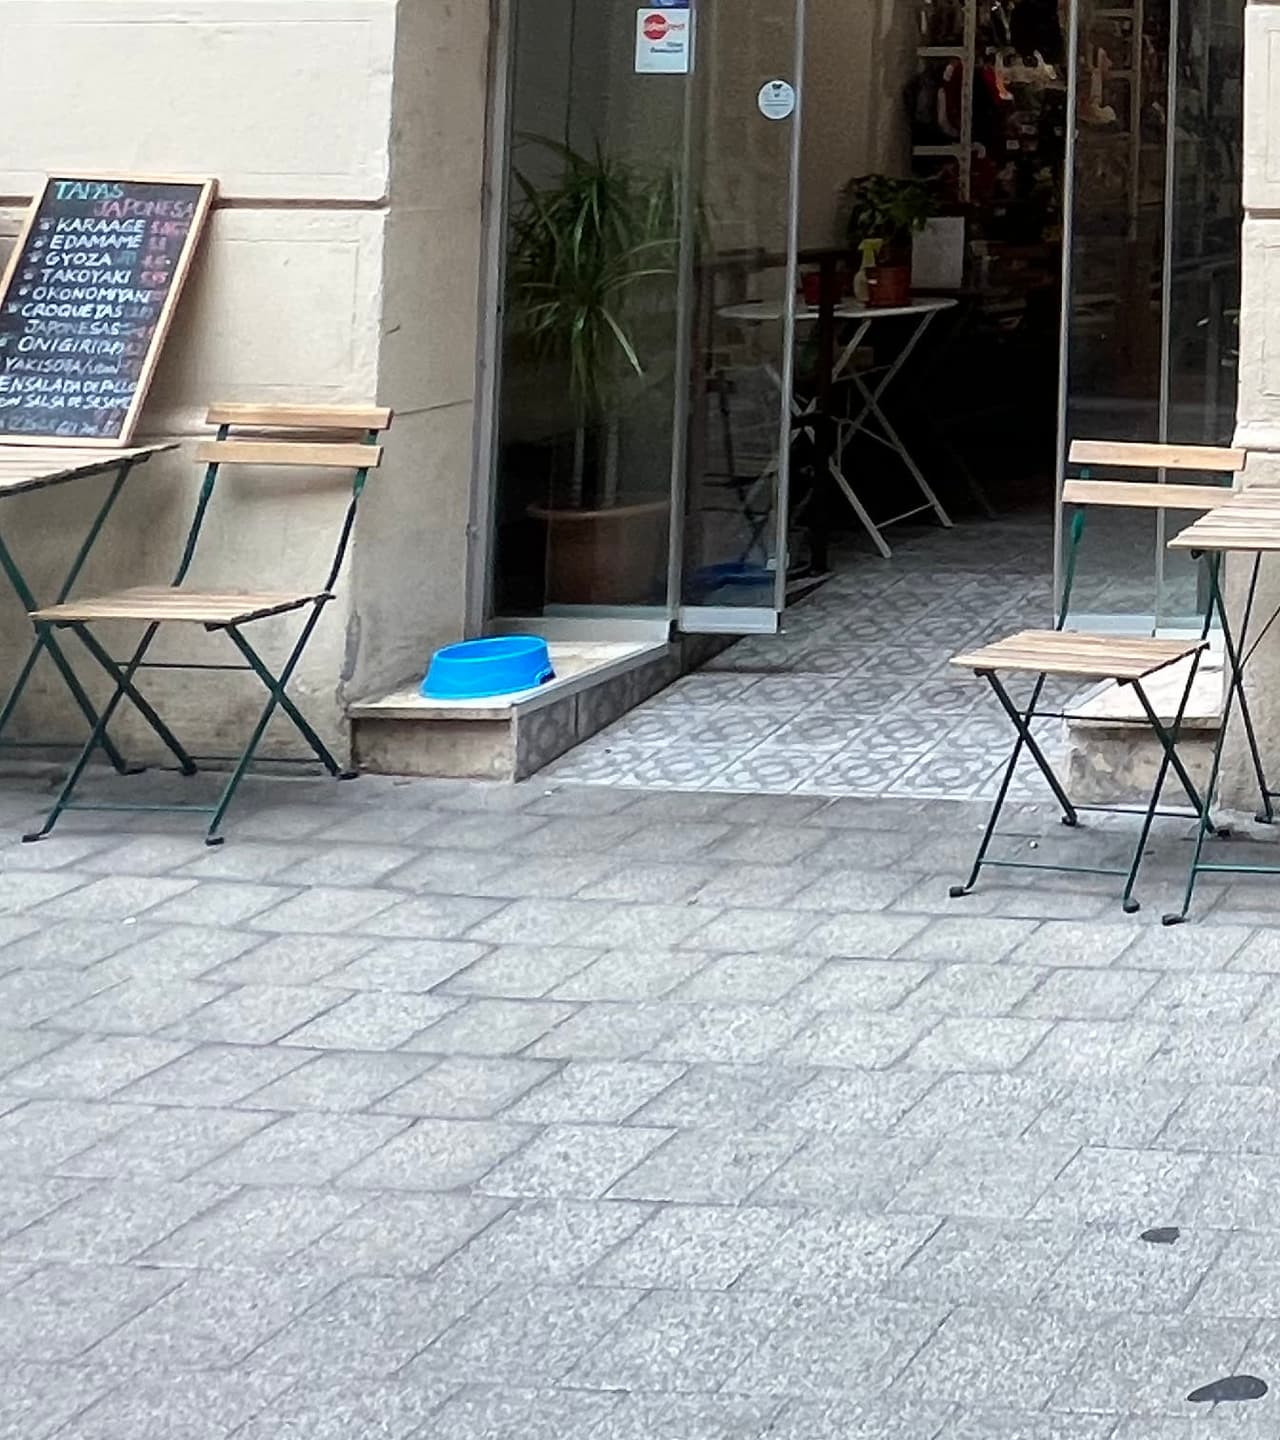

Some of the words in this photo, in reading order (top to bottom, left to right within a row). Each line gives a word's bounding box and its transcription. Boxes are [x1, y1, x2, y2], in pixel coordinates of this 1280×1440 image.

[55, 181, 124, 200] TAPAS
[56, 218, 146, 233] KARAAGE
[50, 234, 143, 250] EDAMAME
[45, 251, 112, 266] GYOZA
[41, 268, 132, 284] TAKOYAKI
[21, 304, 123, 319] CROQUETAS
[24, 320, 122, 336] JAPONESAS
